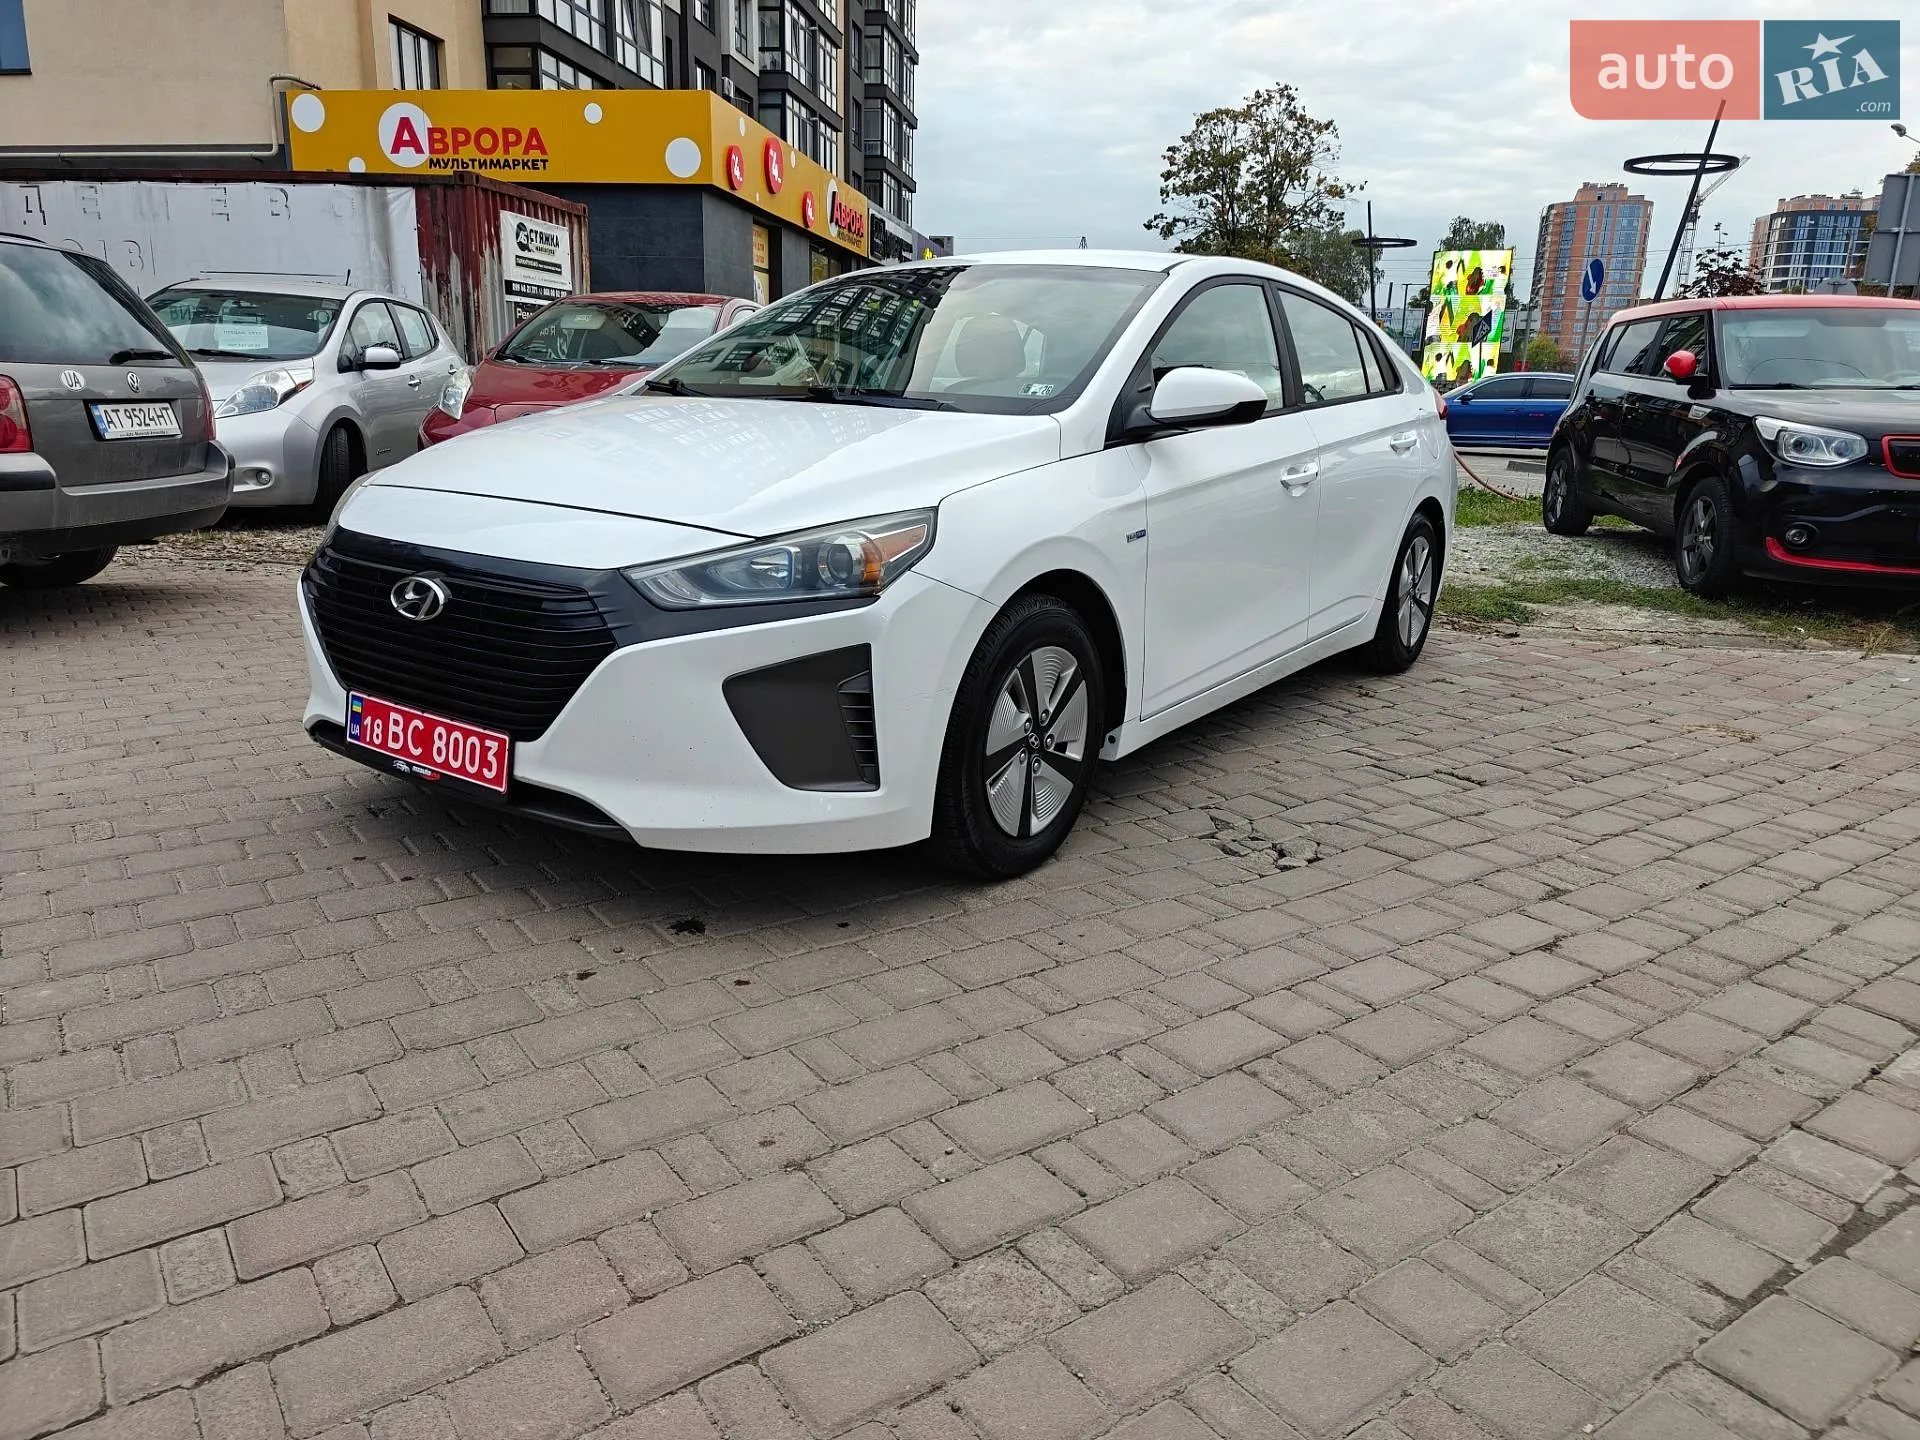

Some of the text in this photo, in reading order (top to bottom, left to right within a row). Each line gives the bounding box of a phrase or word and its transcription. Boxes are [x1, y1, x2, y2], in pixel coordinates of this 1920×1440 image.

[390, 117, 548, 155] АВРОРА
[429, 157, 549, 170] МУЛЬТИМАРКЕТ
[63, 372, 81, 388] UA
[104, 409, 124, 429] AT
[350, 723, 360, 737] UA
[363, 711, 499, 779] 18 BC 8003
